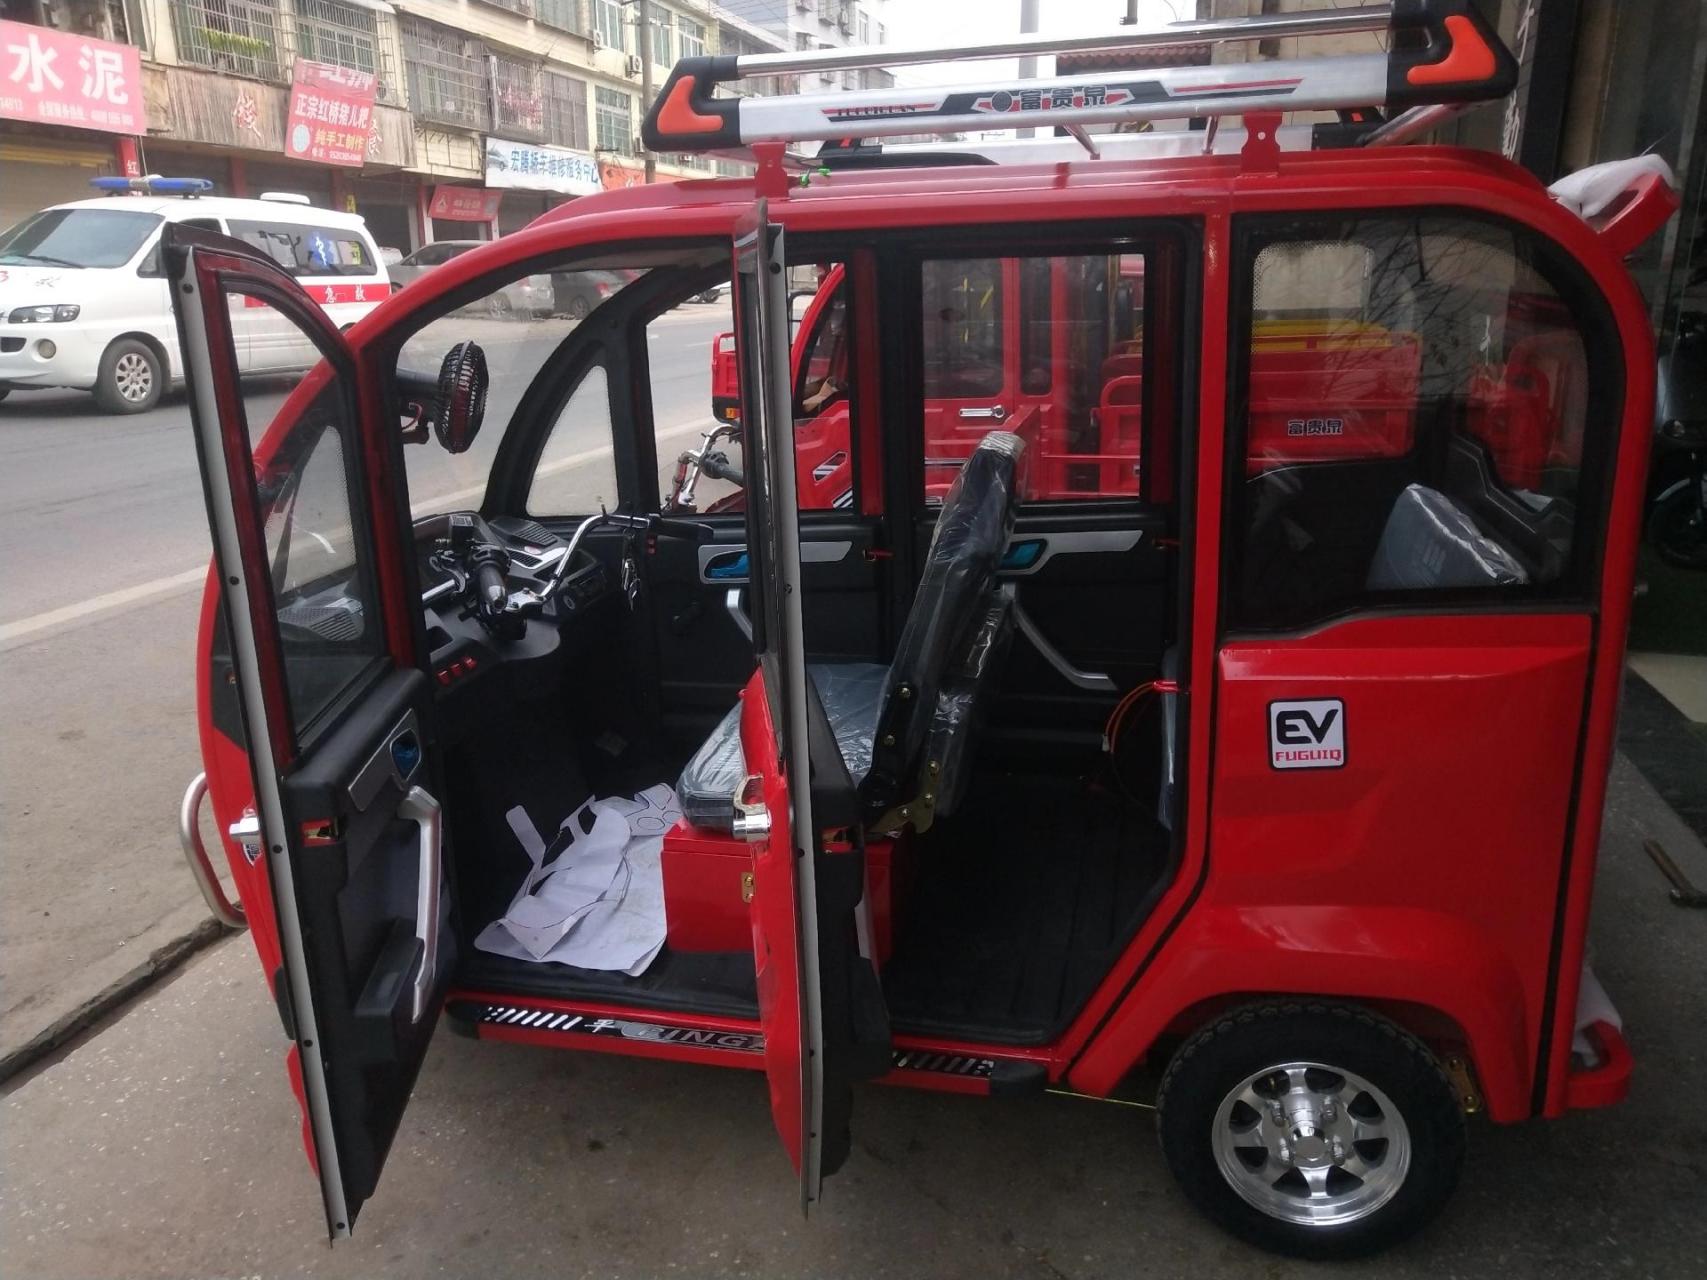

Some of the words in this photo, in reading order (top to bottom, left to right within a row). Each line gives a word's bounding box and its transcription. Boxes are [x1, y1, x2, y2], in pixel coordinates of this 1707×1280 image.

[7, 32, 129, 105] 水泥
[1275, 708, 1339, 745] EV
[1275, 749, 1342, 762] FUGUIQ
